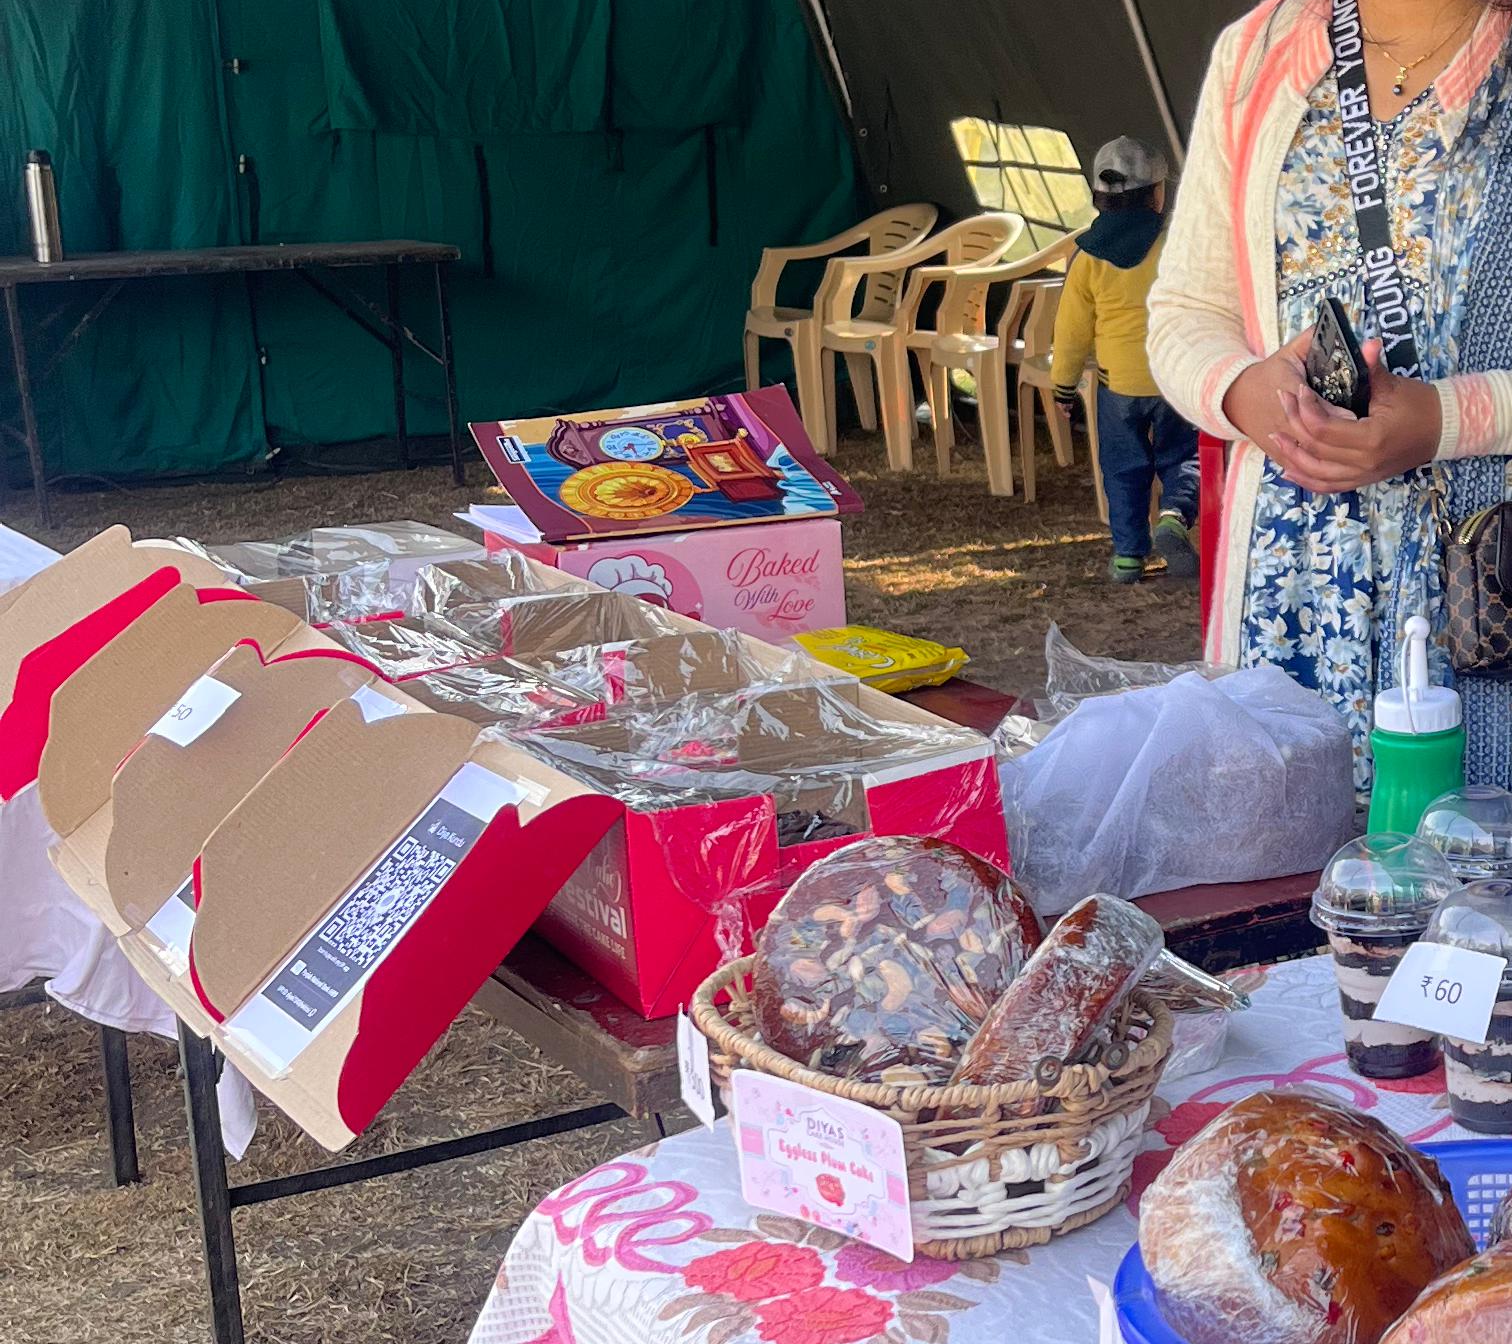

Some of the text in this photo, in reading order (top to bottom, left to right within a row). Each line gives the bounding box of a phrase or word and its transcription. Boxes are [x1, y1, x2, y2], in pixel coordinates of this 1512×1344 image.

[1340, 84, 1383, 211] FOREVER
[1365, 245, 1413, 353] YOUNG
[726, 547, 820, 588] Baked
[734, 584, 815, 621] With Love
[1420, 974, 1463, 1006] ₹60
[807, 1117, 844, 1139] DIYAS
